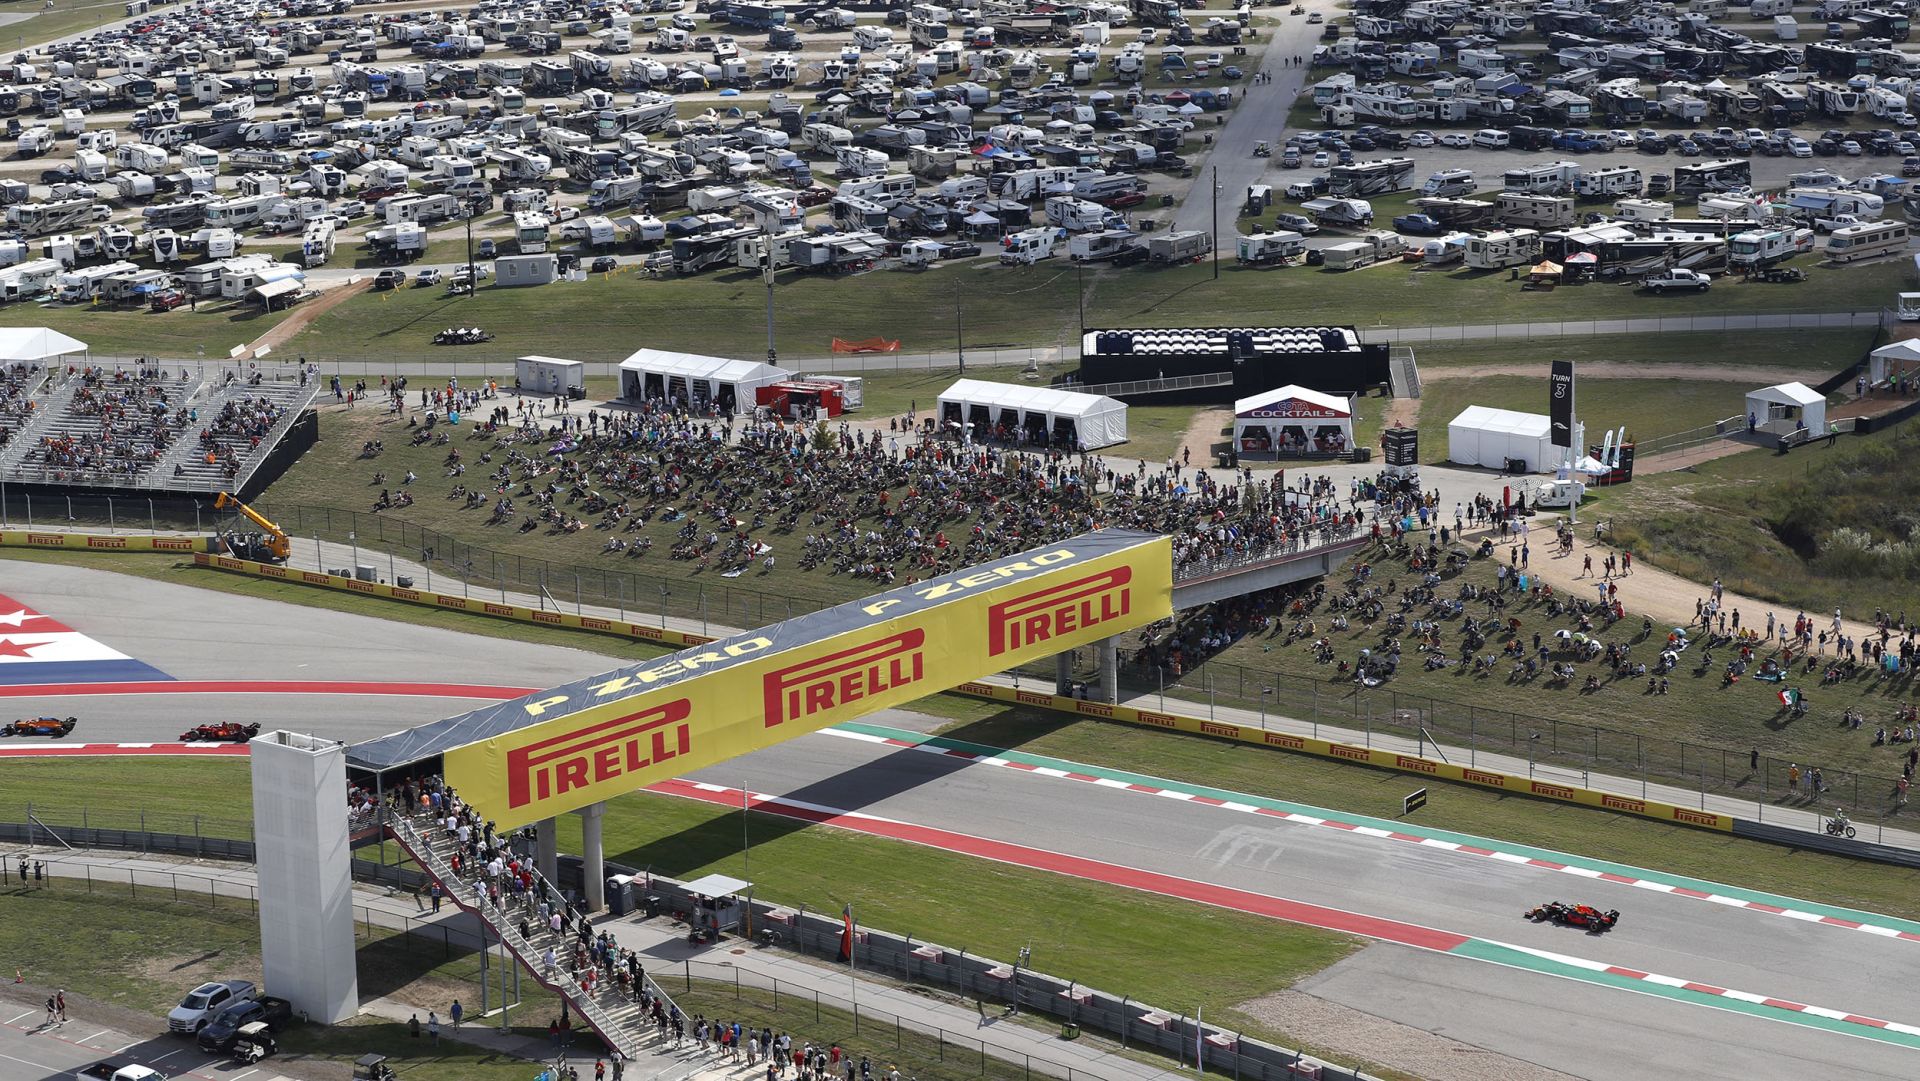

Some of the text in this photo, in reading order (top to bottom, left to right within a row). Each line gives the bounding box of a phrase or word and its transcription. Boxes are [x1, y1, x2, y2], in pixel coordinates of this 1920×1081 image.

[1552, 374, 1571, 382] TURN
[1554, 383, 1567, 398] 3
[1277, 401, 1310, 411] COTA
[28, 534, 64, 545] PIRELLI
[88, 537, 126, 548] PIRELLI
[152, 539, 192, 550] PIRELLI
[914, 550, 1076, 600] ZERO
[989, 565, 1132, 656] PIRELLI
[524, 636, 773, 716] P ZERO
[764, 628, 925, 728] PIRELLI
[507, 698, 692, 810] PIRELLI
